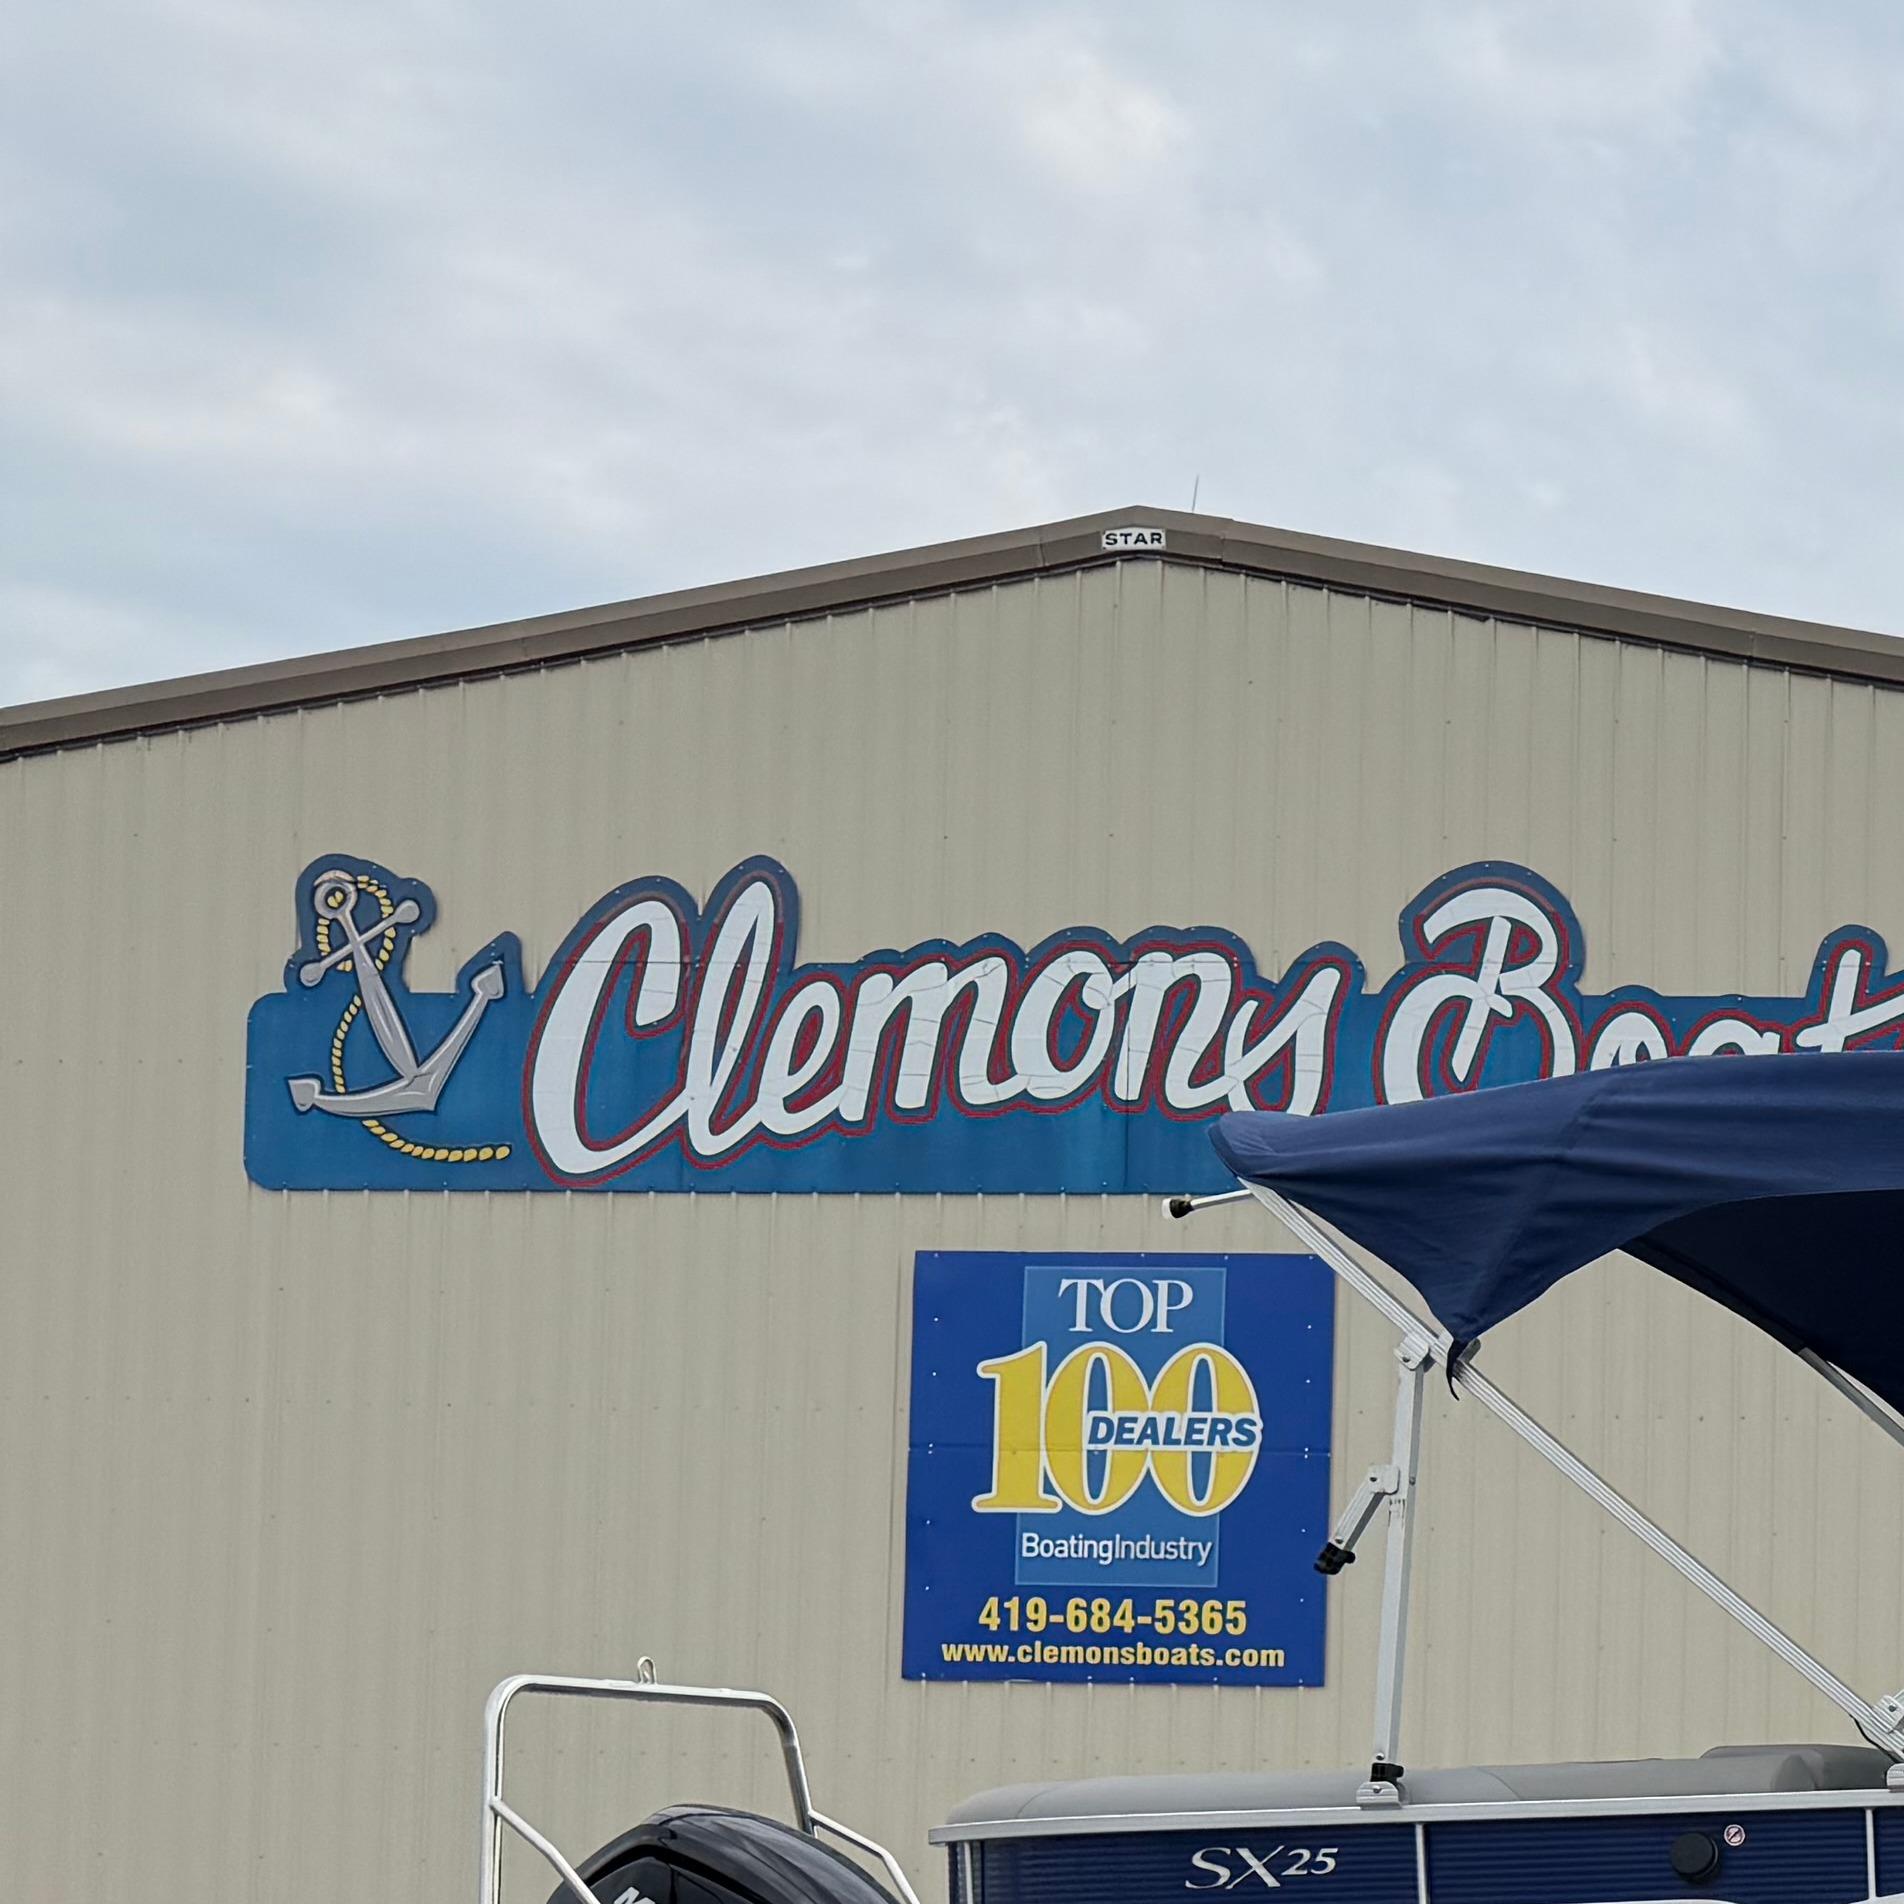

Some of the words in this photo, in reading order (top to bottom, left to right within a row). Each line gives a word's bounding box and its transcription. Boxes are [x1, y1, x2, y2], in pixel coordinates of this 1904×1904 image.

[1105, 532, 1163, 546] STAR
[531, 880, 1341, 1175] Clemons
[1058, 1278, 1194, 1334] TOP
[971, 1341, 1261, 1517] 100
[1087, 1416, 1258, 1447] DEALERS
[978, 1596, 1248, 1636] 419-684-5365
[942, 1640, 1286, 1668] www.clemonsboats.com
